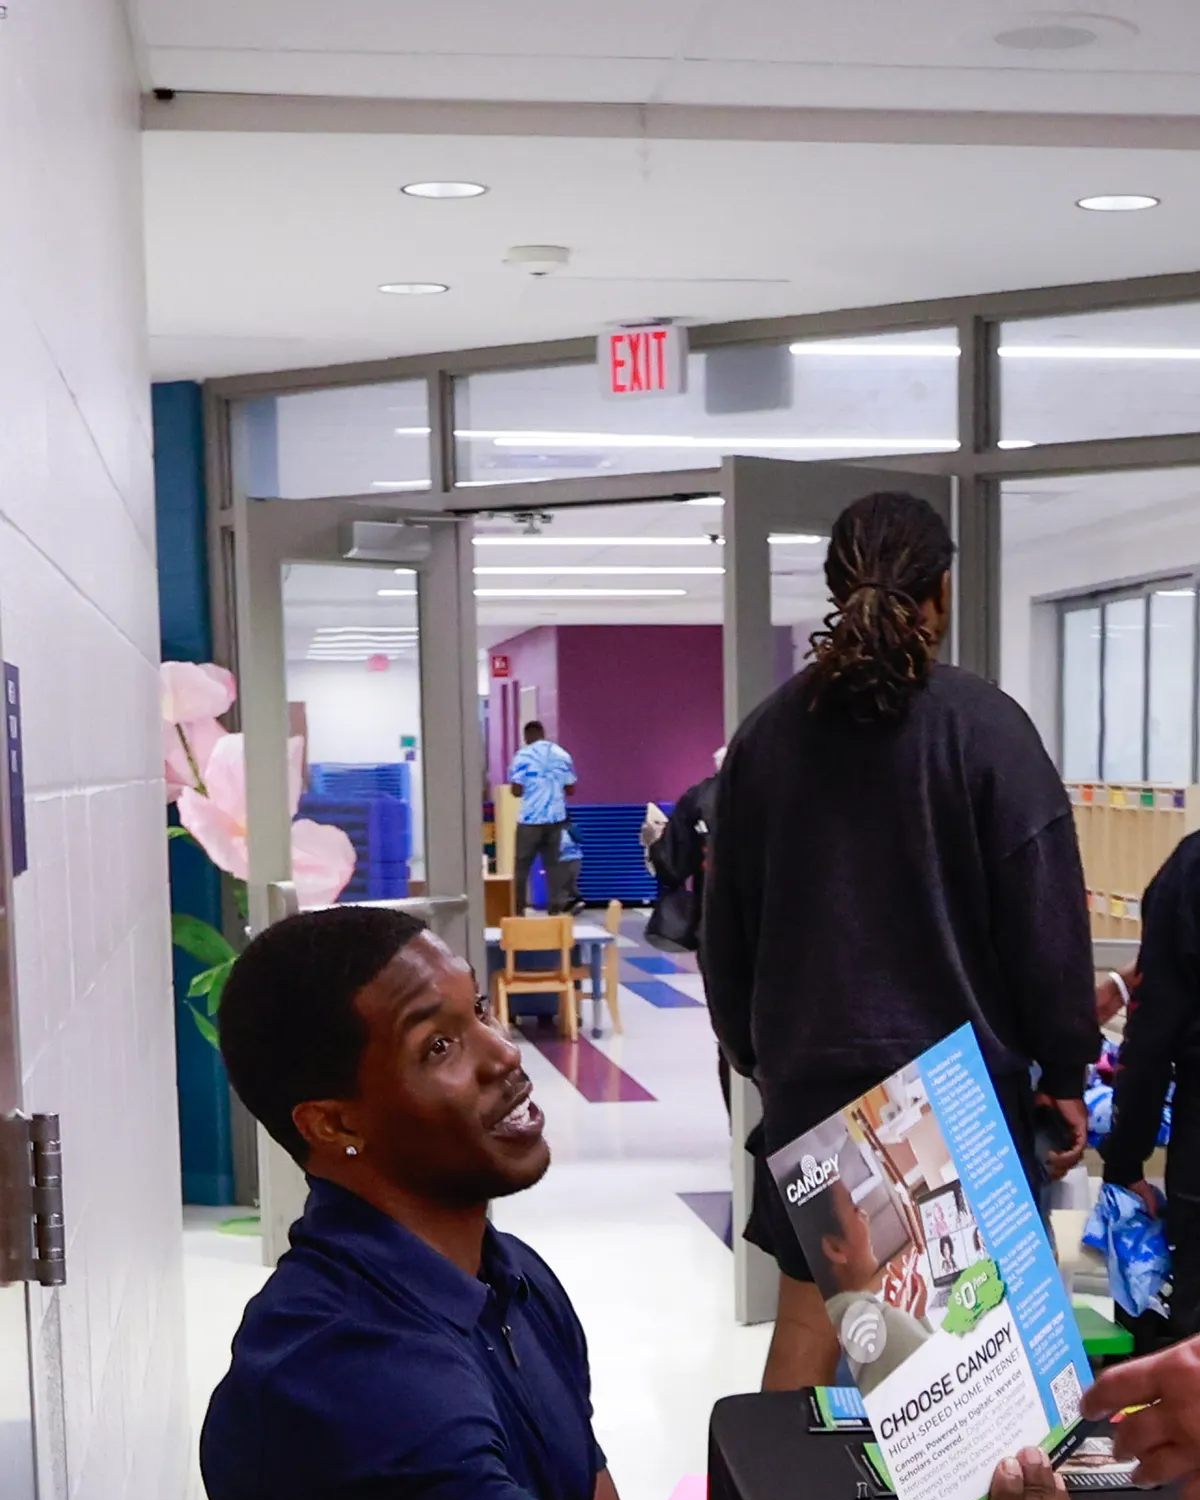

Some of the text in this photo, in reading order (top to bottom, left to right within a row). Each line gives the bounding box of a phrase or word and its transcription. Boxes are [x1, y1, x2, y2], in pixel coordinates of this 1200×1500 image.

[610, 331, 666, 392] EXIT
[787, 1153, 839, 1204] CANOPY
[881, 1373, 954, 1439] CHOOSE
[956, 1322, 1011, 1384] CANOPY
[889, 1348, 1021, 1458] HIGH-SPEED HOME INTERNET
[959, 1416, 968, 1426] by
